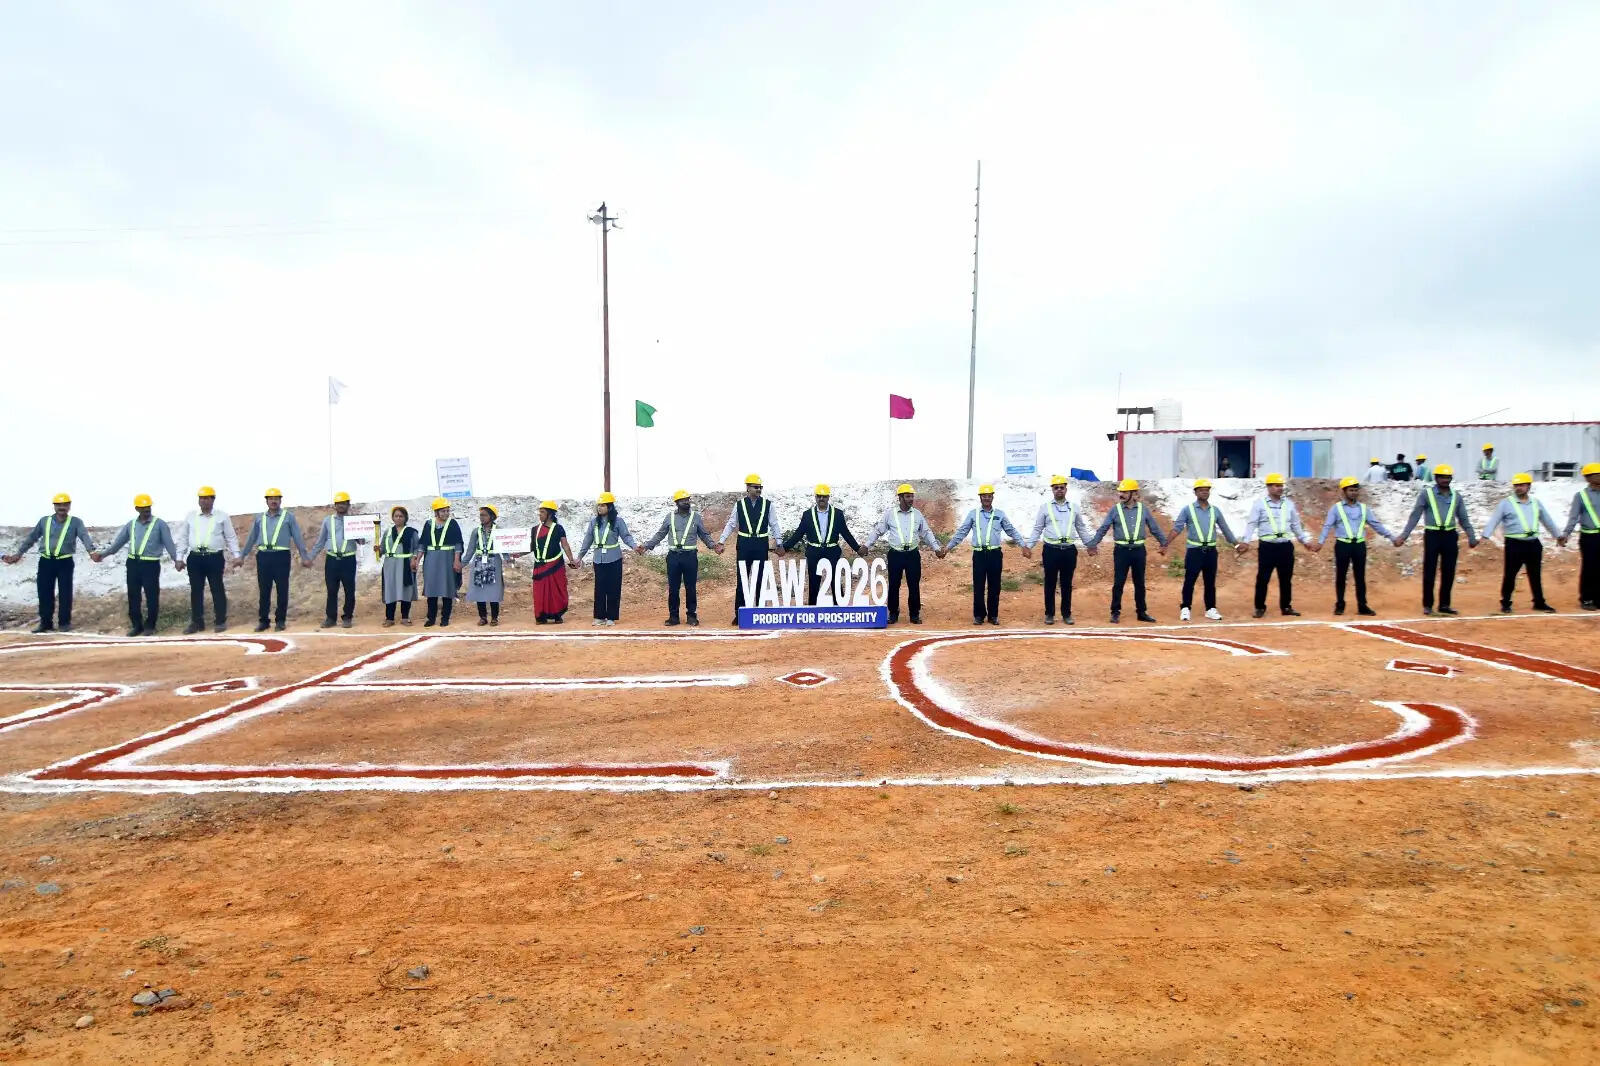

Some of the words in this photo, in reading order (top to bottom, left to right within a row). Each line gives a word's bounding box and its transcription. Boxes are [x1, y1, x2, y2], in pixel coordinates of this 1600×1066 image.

[738, 558, 807, 607] VAW
[816, 557, 888, 607] 2026
[752, 613, 794, 624] PROBITY
[796, 613, 815, 624] FOR
[818, 612, 877, 623] PROSPERITY
